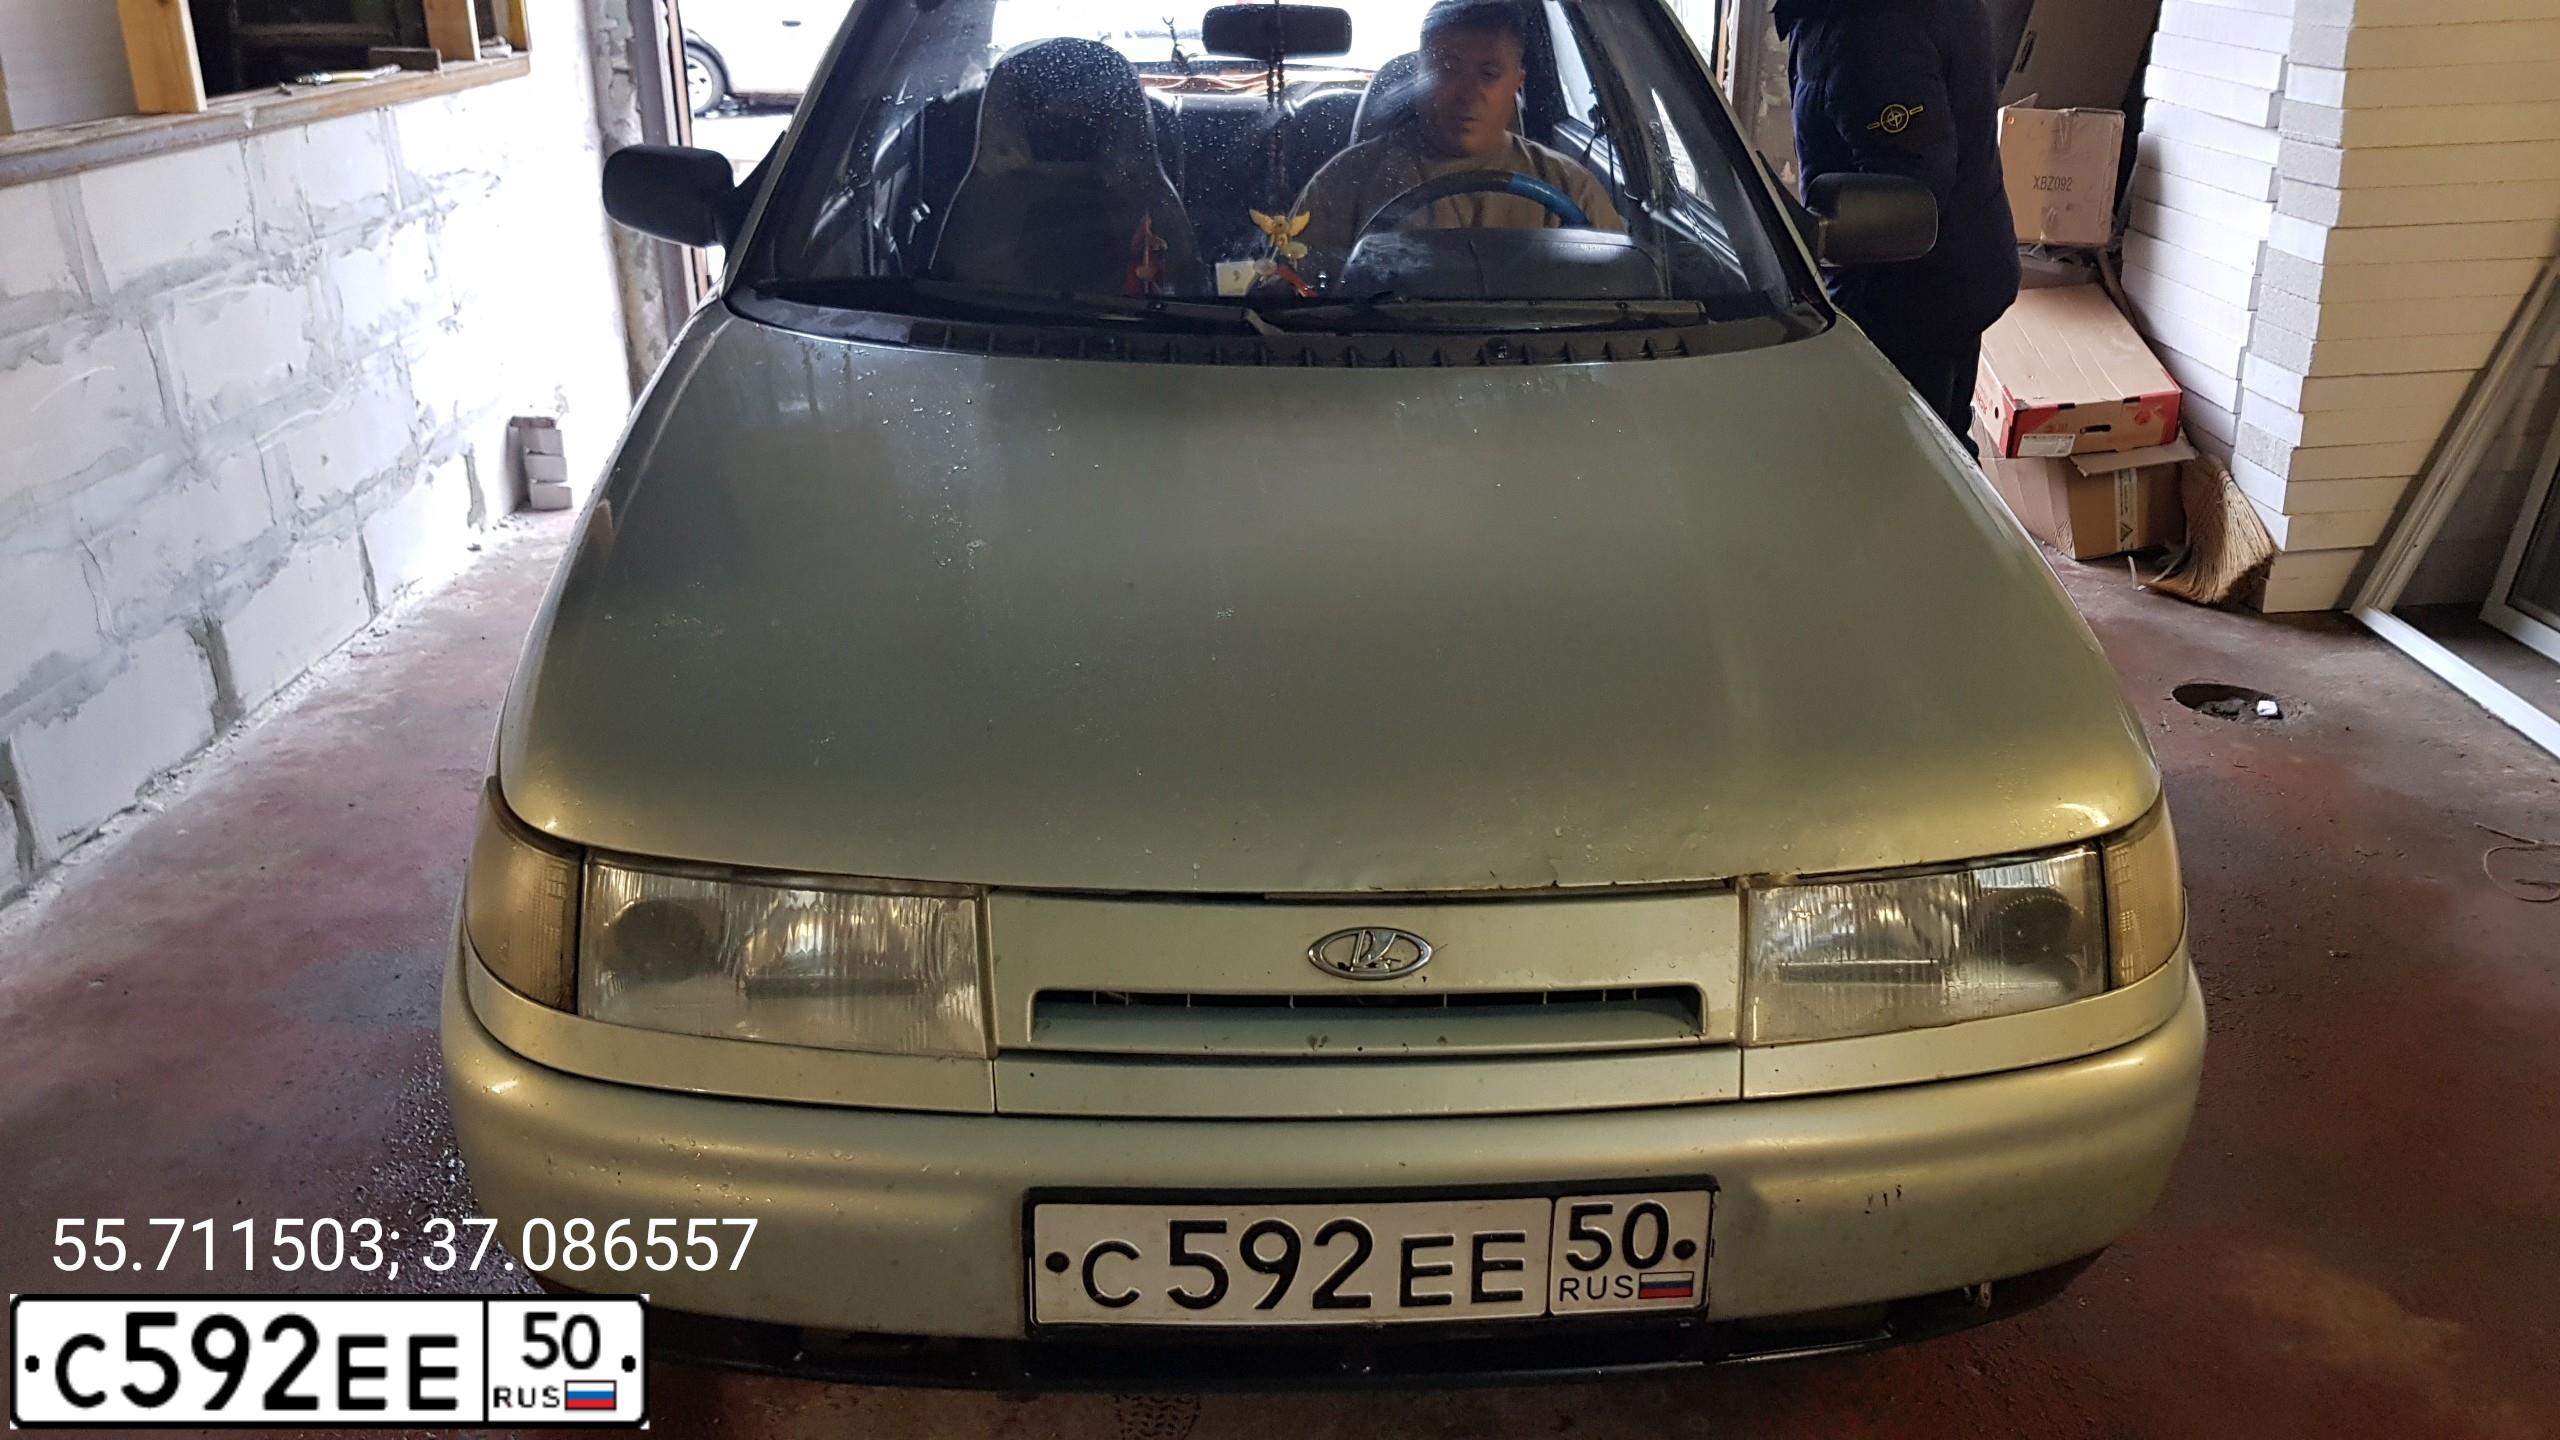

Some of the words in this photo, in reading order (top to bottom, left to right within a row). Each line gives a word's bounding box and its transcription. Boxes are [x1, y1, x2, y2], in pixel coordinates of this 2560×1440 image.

[2033, 175, 2072, 192] XBZ092
[1565, 1201, 1670, 1273] 50
[1559, 1274, 1635, 1303] RUS
